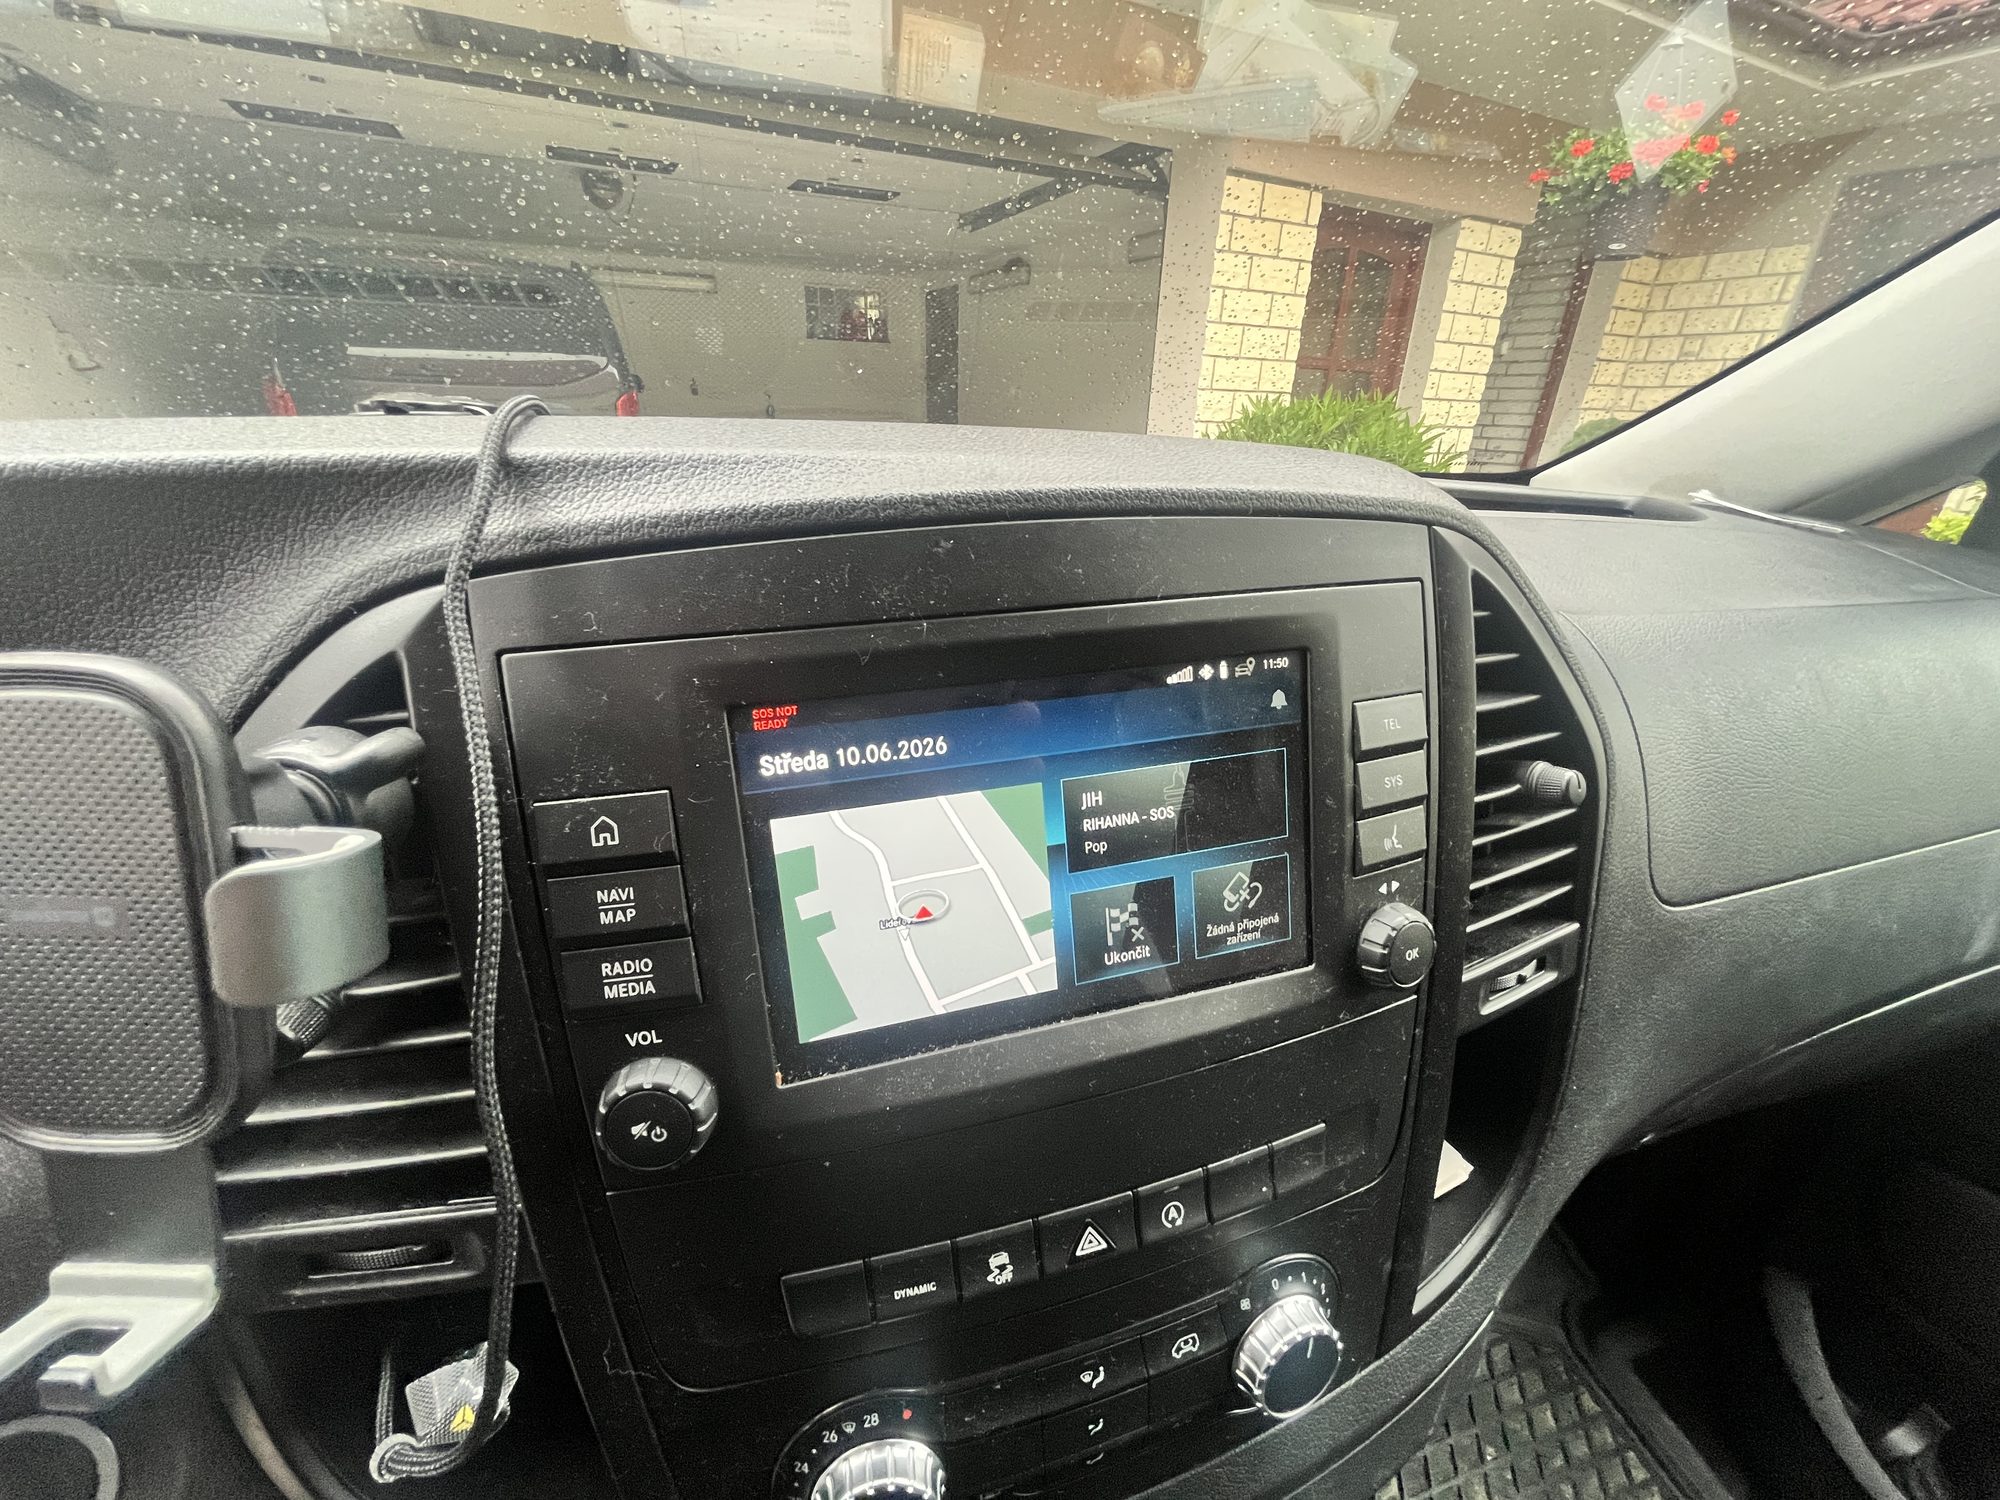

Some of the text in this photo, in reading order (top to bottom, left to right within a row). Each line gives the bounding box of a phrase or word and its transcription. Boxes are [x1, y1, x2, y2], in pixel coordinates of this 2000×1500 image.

[1263, 657, 1289, 669] 11:50
[752, 705, 798, 720] SOS NOT
[753, 718, 788, 731] READY
[1383, 717, 1401, 731] TEL
[759, 735, 948, 777] Středa 10.06.2026
[1384, 774, 1403, 789] SYS
[1081, 791, 1103, 810] JIH
[1083, 811, 1140, 832] RIHANNA
[1149, 805, 1175, 822] SOS
[1084, 841, 1108, 856] Pop
[596, 887, 635, 904] NAVI
[599, 908, 637, 925] MAP
[1206, 912, 1280, 938] Žádná připojená
[1226, 928, 1261, 946] zařízení
[1104, 946, 1150, 966] Ukončit
[1406, 946, 1419, 961] OK
[601, 958, 653, 977] RADIO
[603, 979, 656, 999] MEDIA
[625, 1029, 663, 1047] VOL
[995, 1272, 1013, 1285] OFF
[894, 1281, 937, 1300] DYNAMIC
[863, 1412, 879, 1428] 28
[822, 1429, 838, 1443] 26
[794, 1461, 809, 1474] 24
